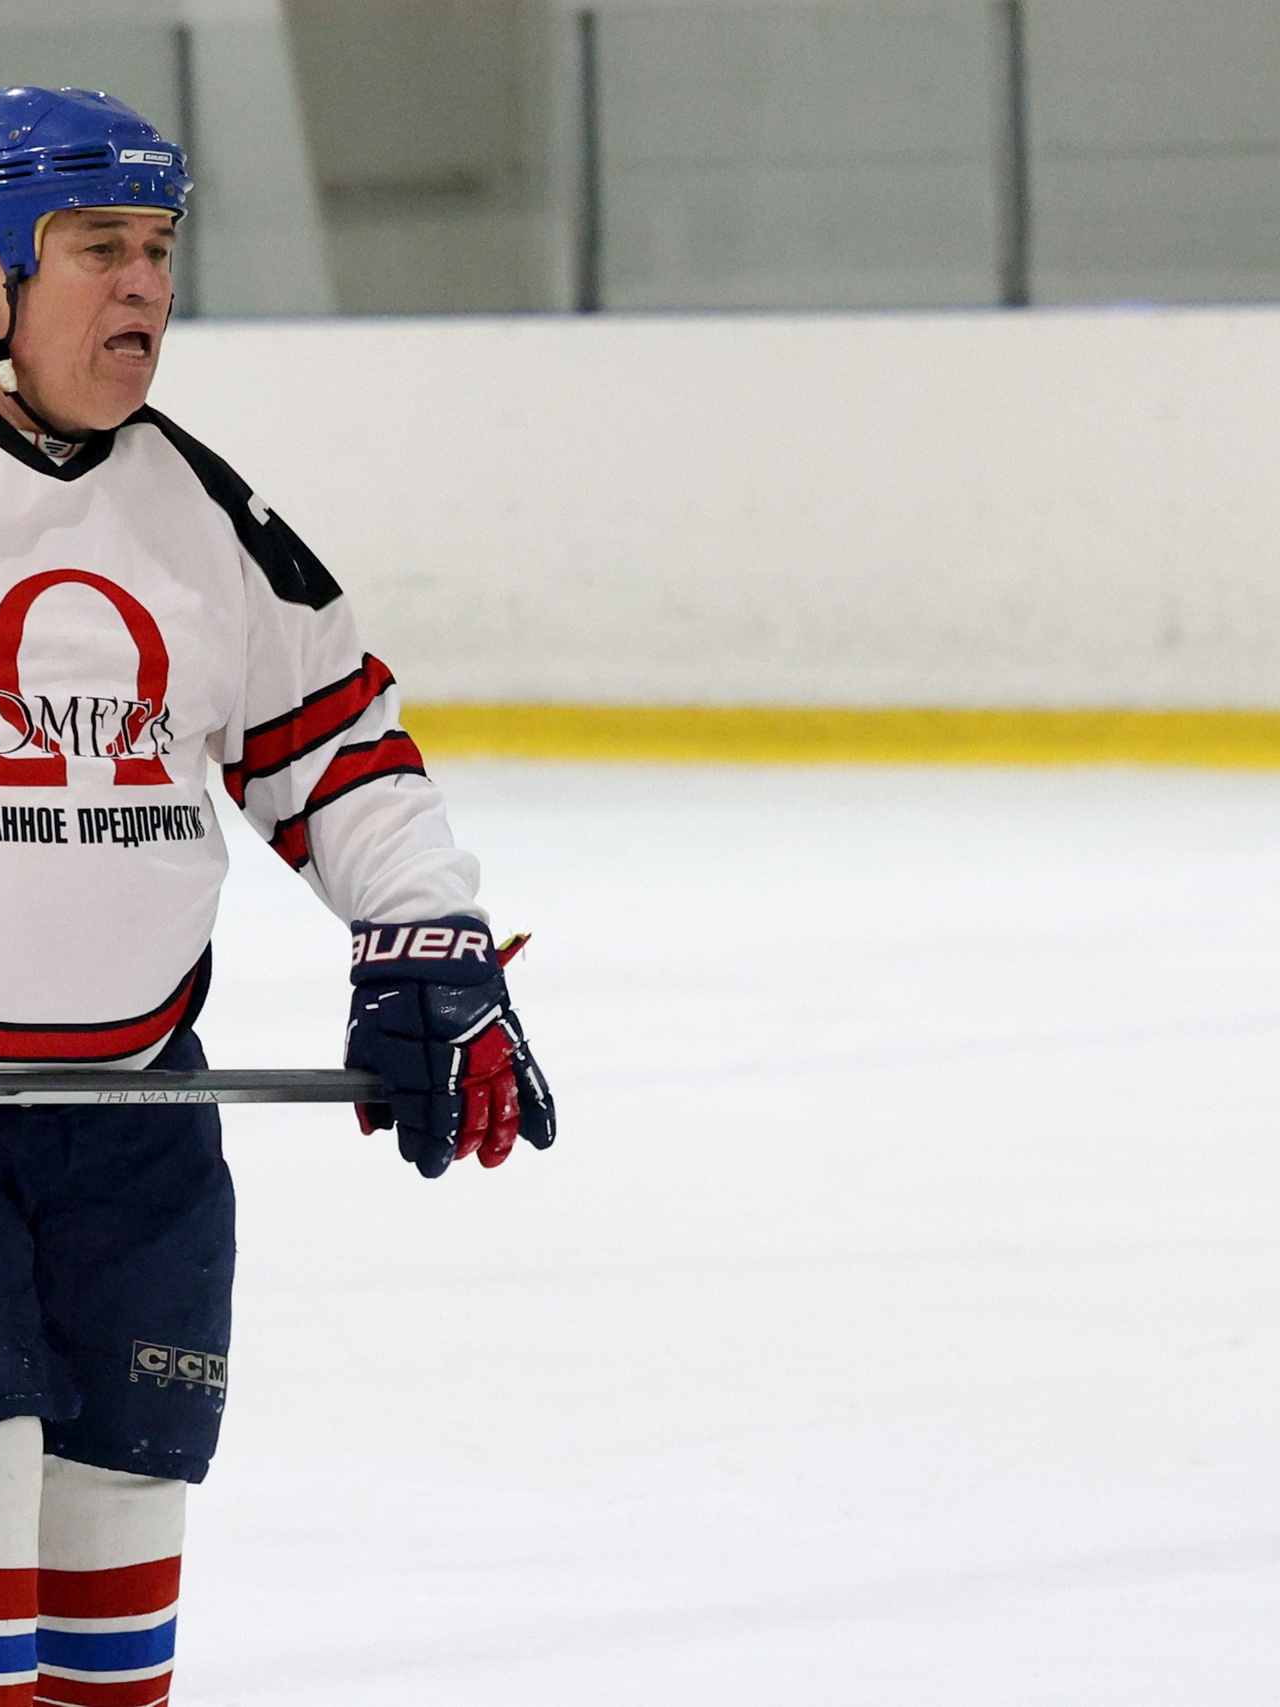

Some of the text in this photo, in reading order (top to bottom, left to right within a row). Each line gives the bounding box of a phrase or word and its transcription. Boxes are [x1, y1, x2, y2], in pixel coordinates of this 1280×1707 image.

[139, 1090, 220, 1103] MATRIX
[134, 1345, 225, 1385] CCM
[128, 1372, 225, 1399] SURA
